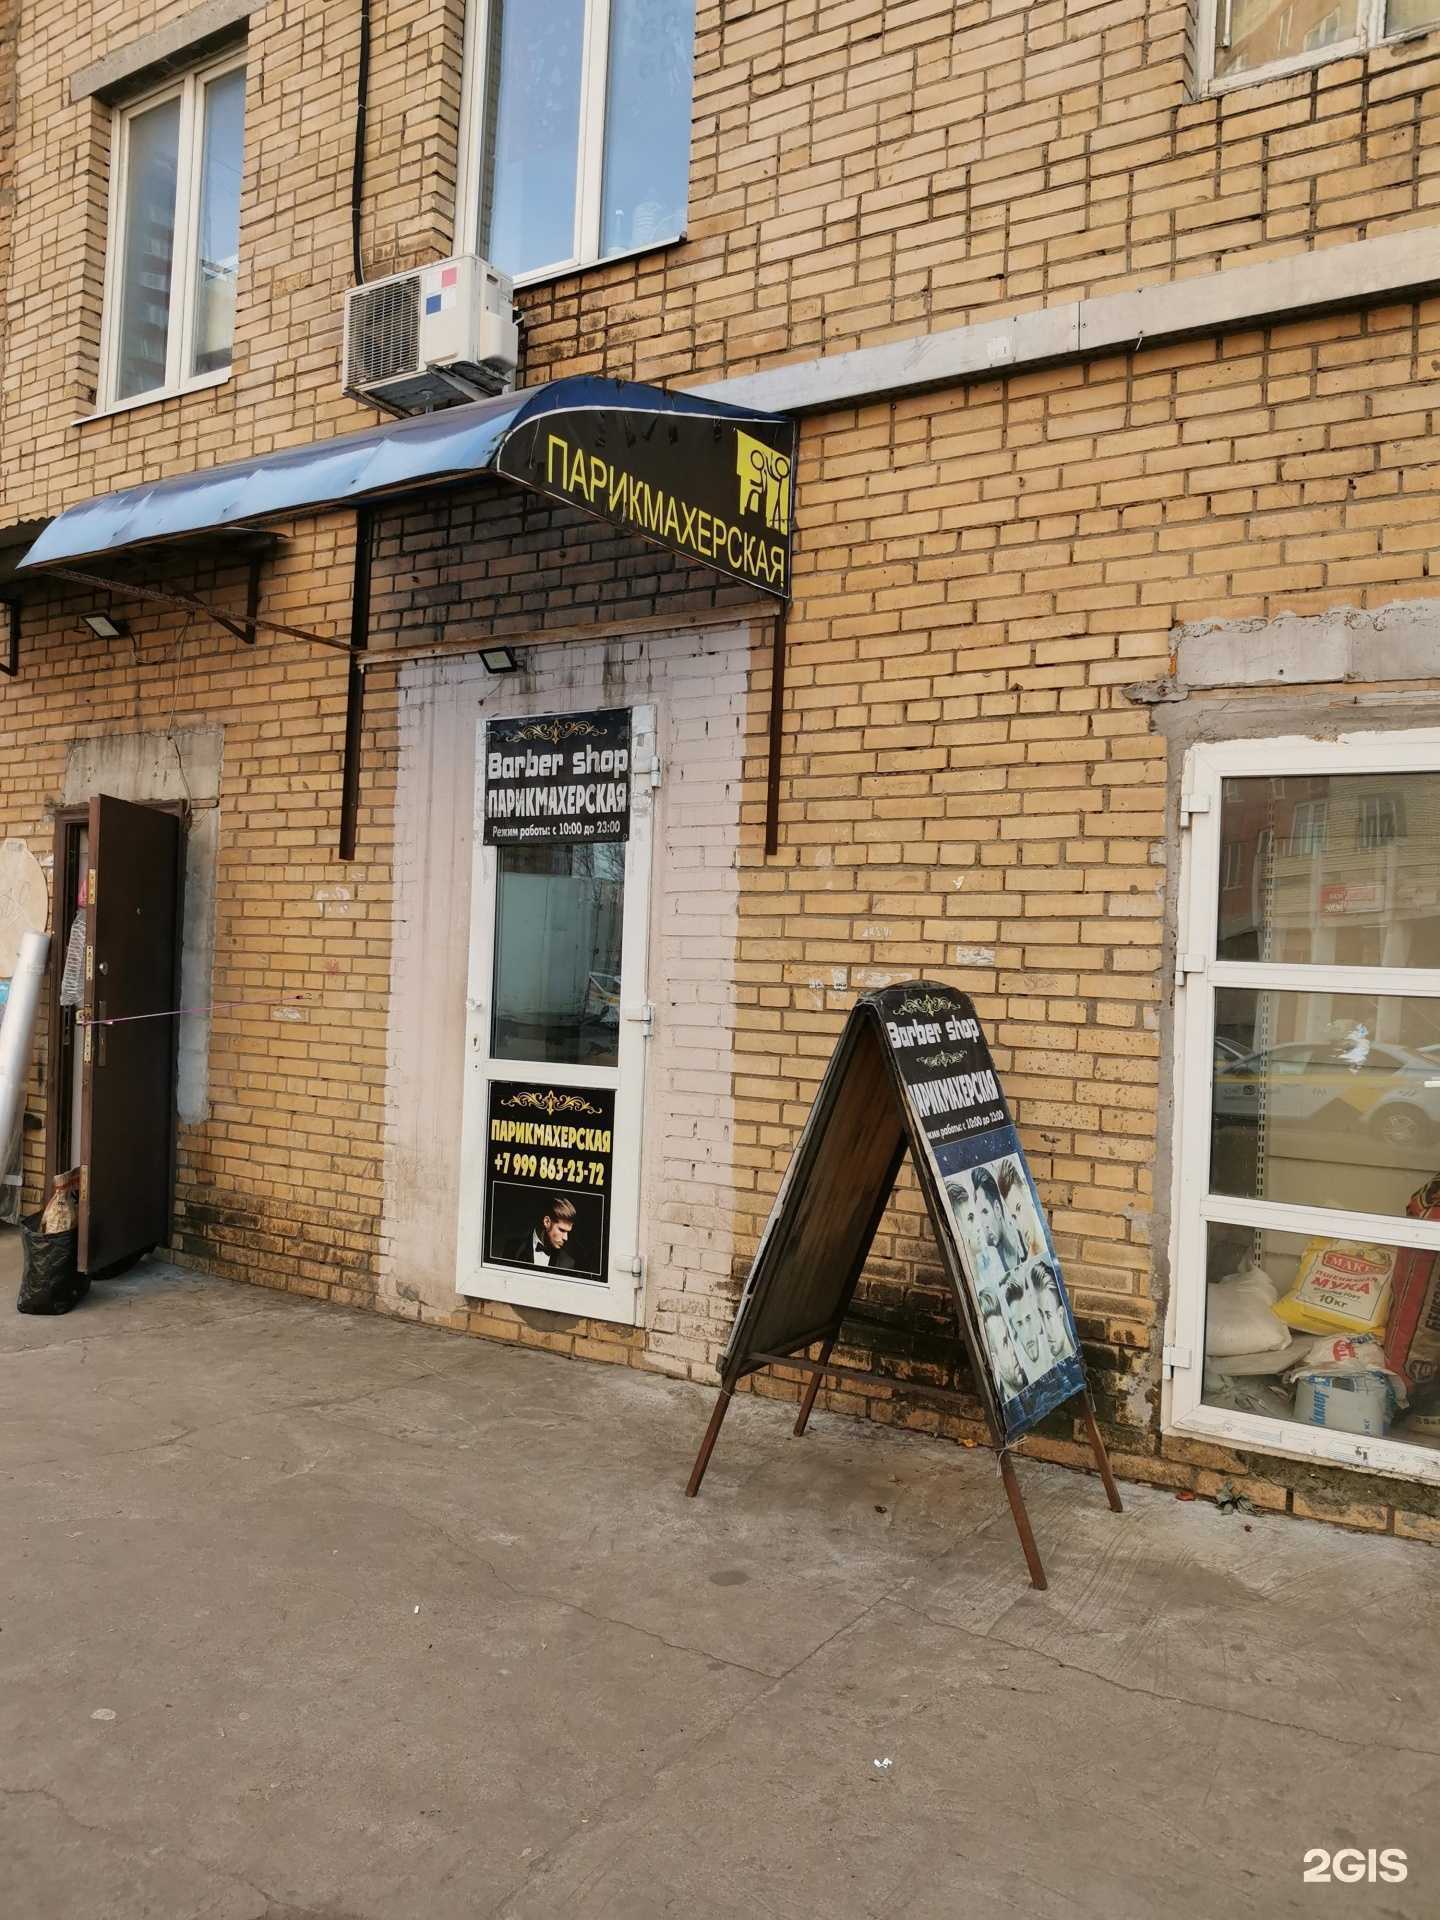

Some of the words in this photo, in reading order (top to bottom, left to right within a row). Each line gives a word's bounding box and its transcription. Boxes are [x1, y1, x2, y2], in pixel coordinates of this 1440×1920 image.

[547, 433, 785, 588] ПАРИКМАХЕРСКАЯ
[487, 749, 564, 779] Barber
[572, 744, 628, 778] shop
[487, 783, 627, 818] ПАРИКМАХЕРСКАЯ
[492, 826, 518, 837] Режим
[519, 824, 551, 840] работы:
[552, 828, 557, 836] с
[559, 822, 582, 835] 10:00
[583, 826, 595, 836] до
[597, 821, 620, 833] 23:00
[886, 1018, 943, 1049] Barber
[945, 1014, 980, 1043] shop
[491, 1119, 611, 1153] ПАРИКМАХЕРСКАЯ
[494, 1152, 511, 1174] +7
[513, 1153, 537, 1177] 999
[540, 1155, 604, 1186] 863-23-72
[1311, 1277, 1370, 1295] МУКА
